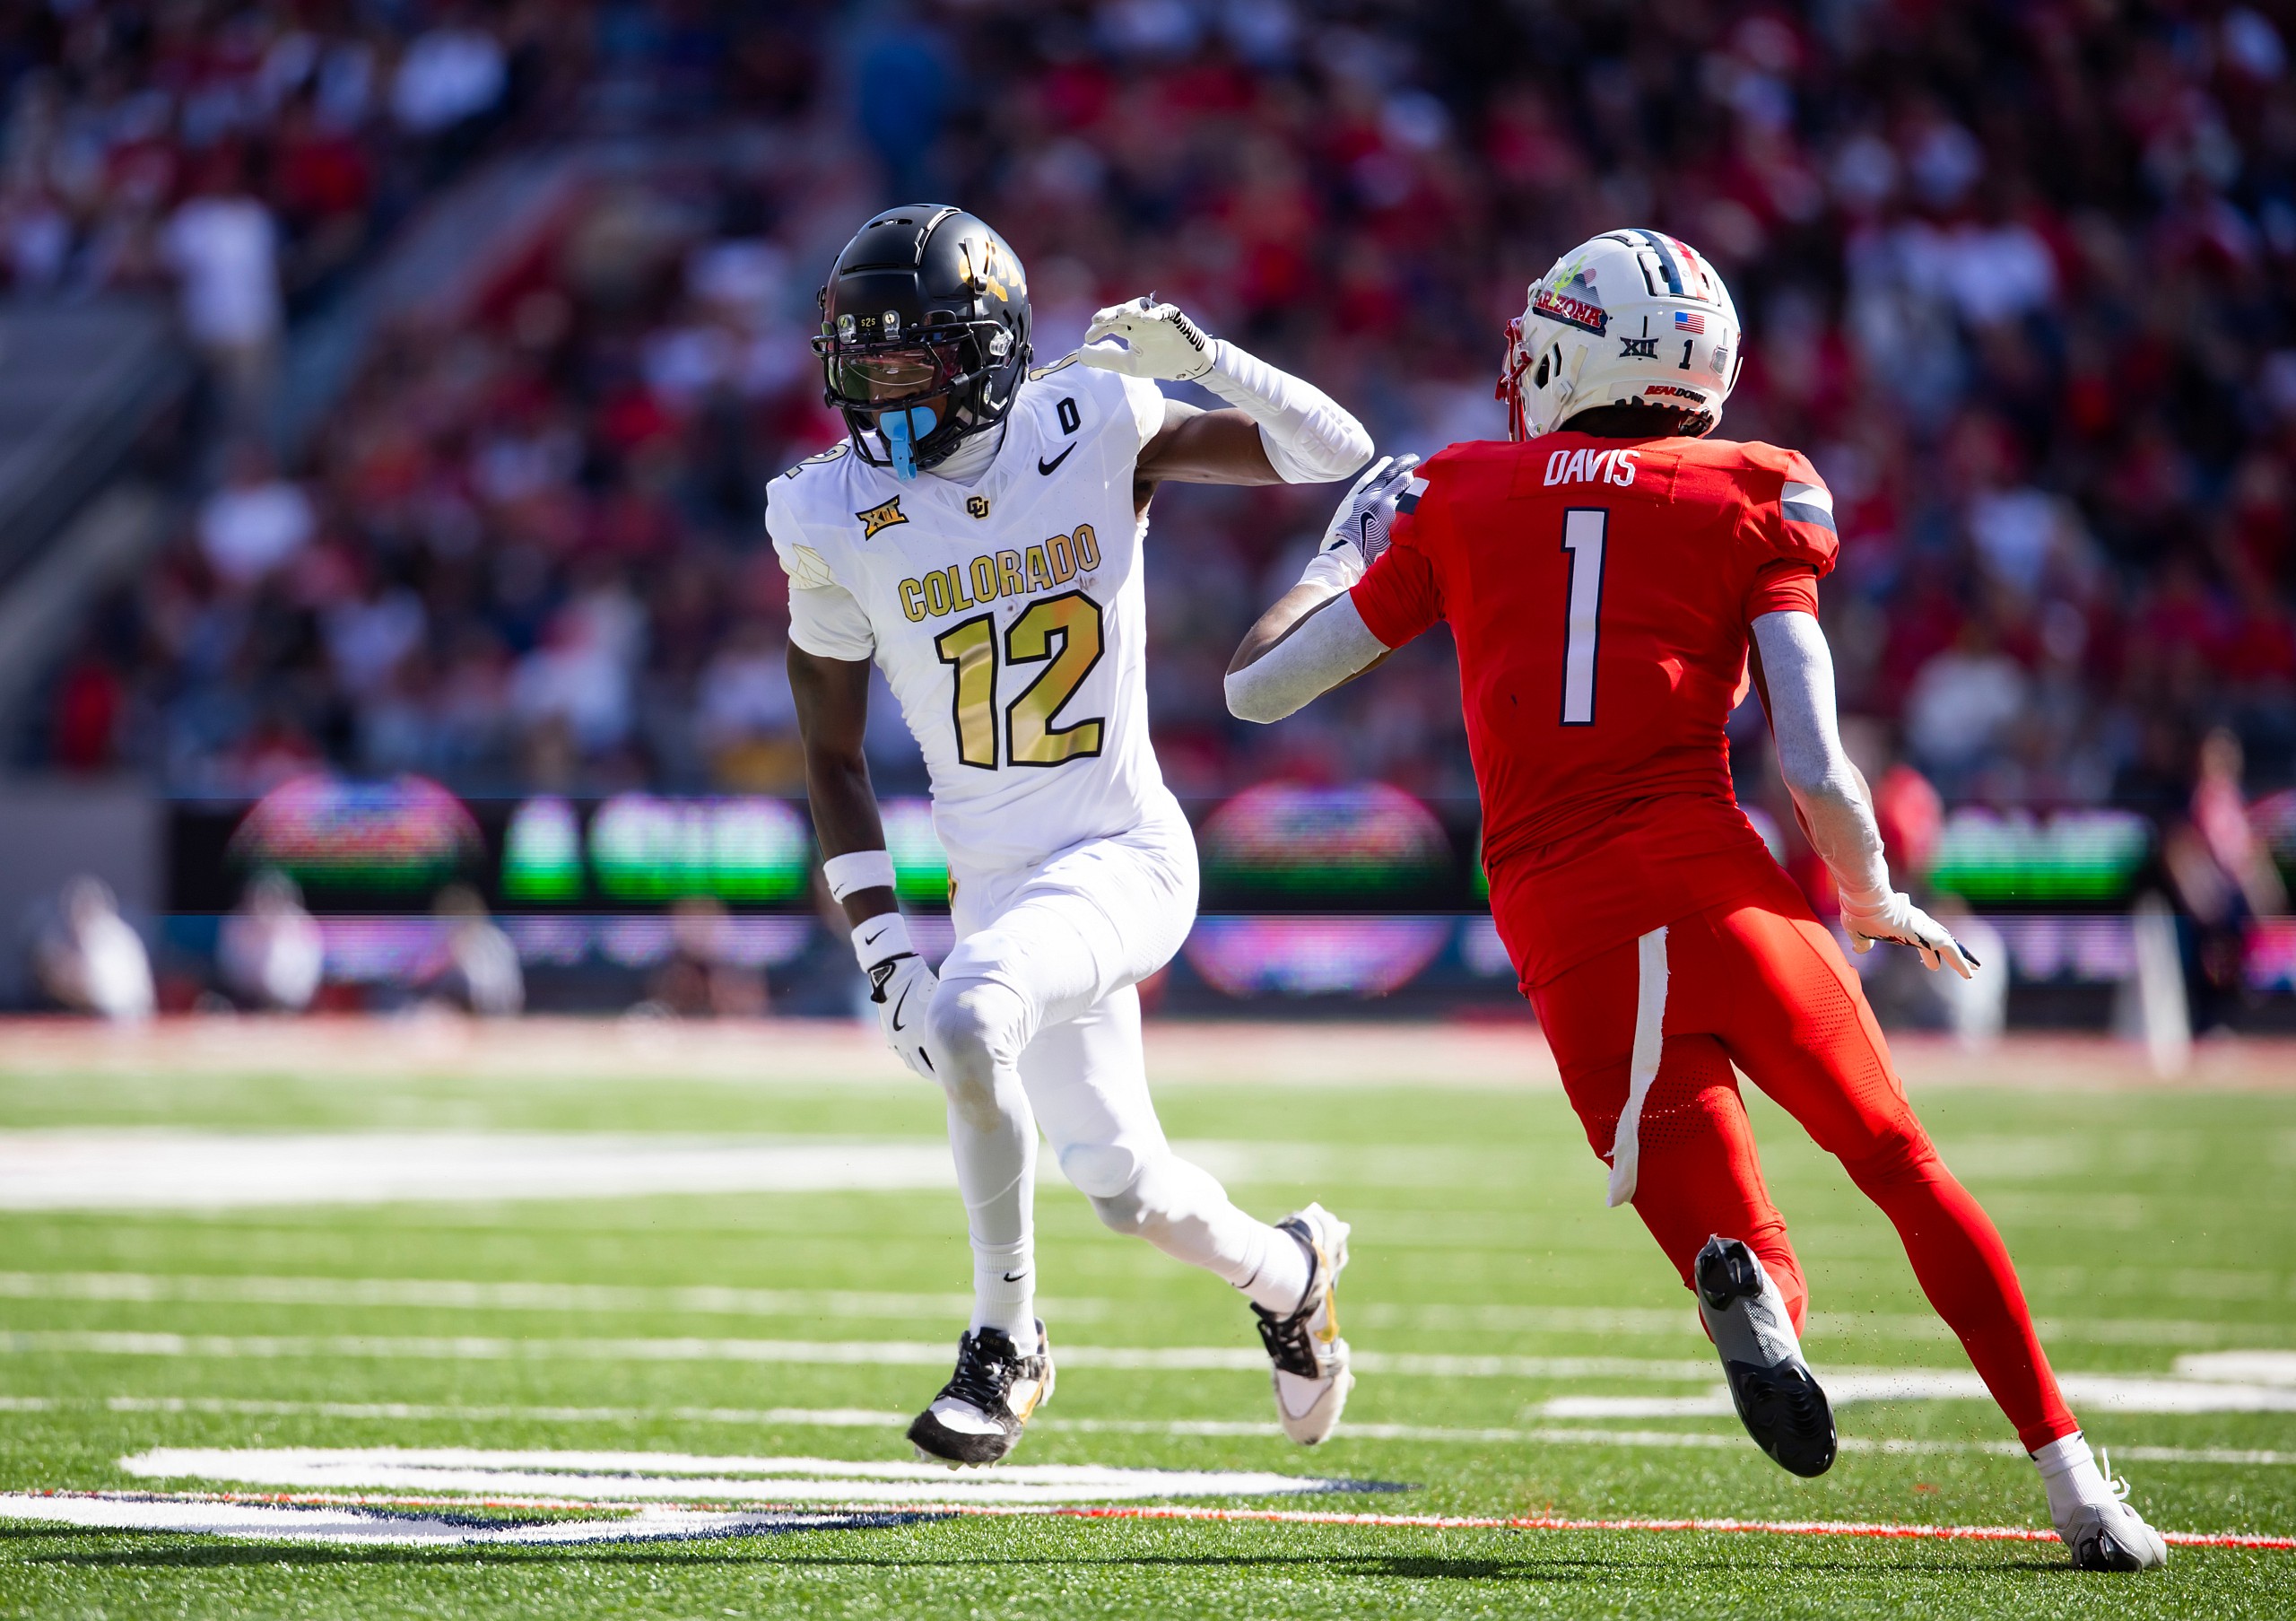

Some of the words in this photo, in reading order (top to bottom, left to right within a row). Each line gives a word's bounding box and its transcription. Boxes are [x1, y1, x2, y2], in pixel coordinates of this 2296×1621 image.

[1535, 290, 1603, 329] ARIZONA
[1619, 336, 1659, 360] XII
[1678, 339, 1693, 370] 1
[1056, 397, 1082, 436] D
[1543, 449, 1640, 487] DAVIS
[898, 523, 1101, 623] COLORADO
[1560, 507, 1610, 727] 1
[933, 588, 1106, 771] 12
